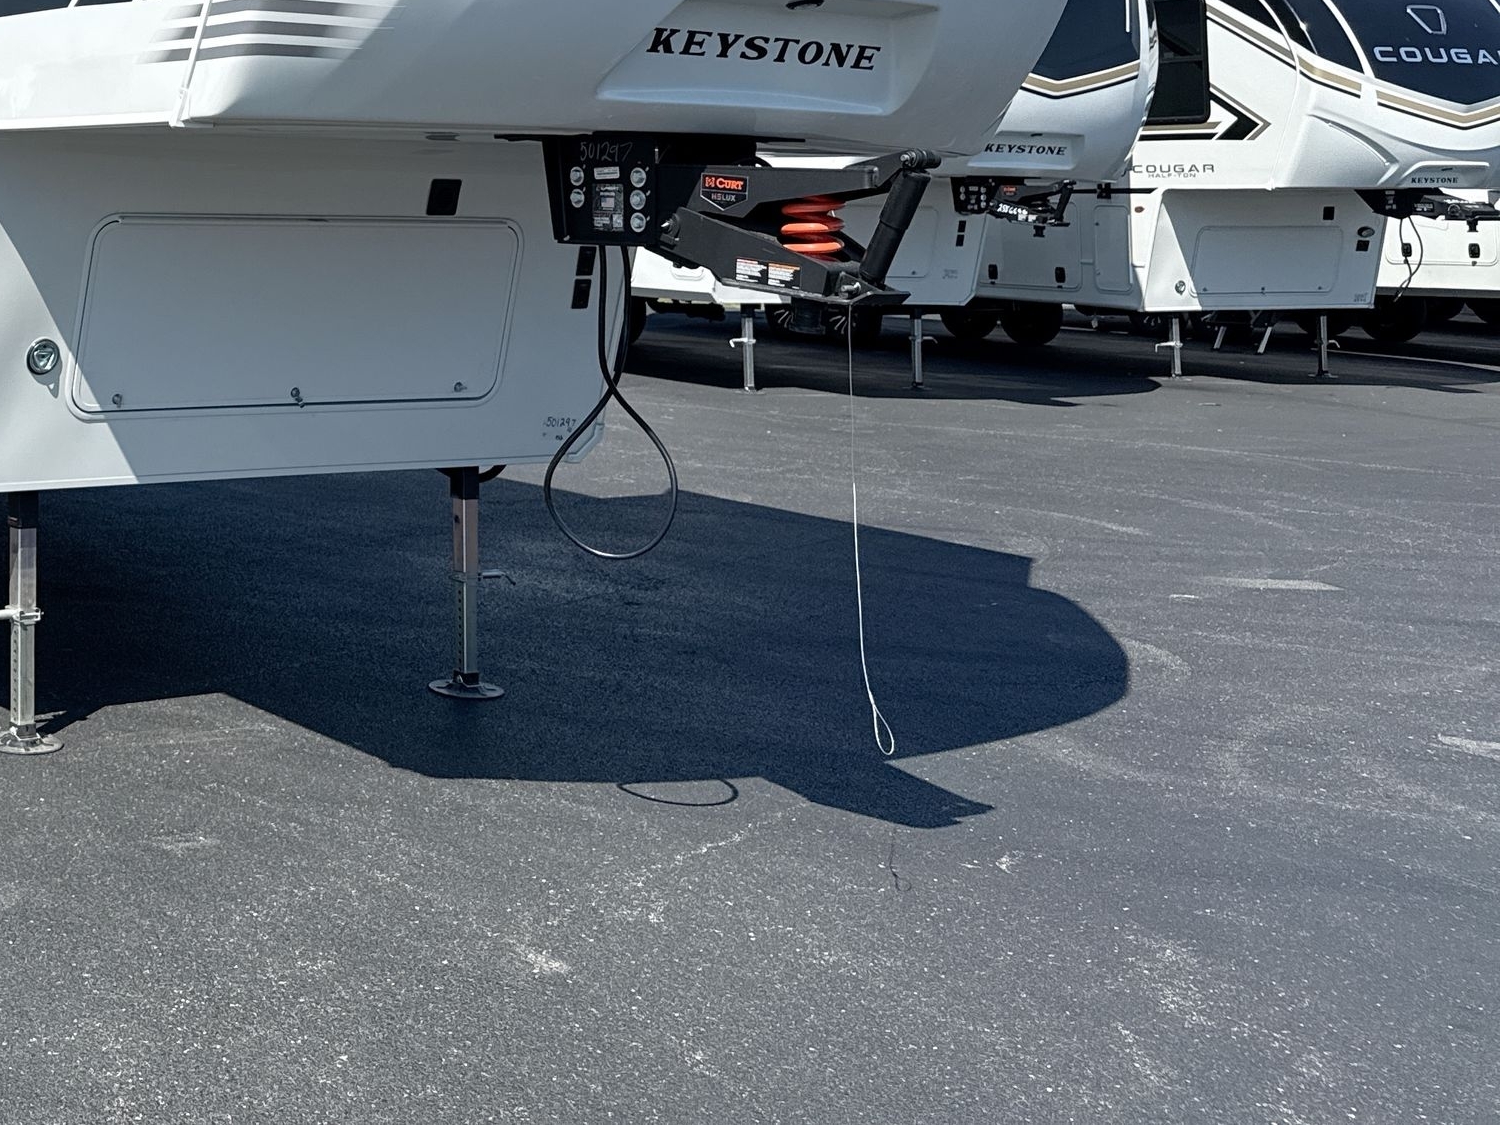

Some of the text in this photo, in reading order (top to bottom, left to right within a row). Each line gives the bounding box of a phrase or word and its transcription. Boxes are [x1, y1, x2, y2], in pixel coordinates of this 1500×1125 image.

[646, 27, 882, 71] KEYSTONE
[1373, 46, 1500, 65] COUGA
[580, 141, 633, 162] 501297
[984, 143, 1067, 156] KEYSTONE
[1132, 164, 1215, 174] COUGAR
[716, 177, 744, 190] CURT
[546, 416, 577, 427] 501297
